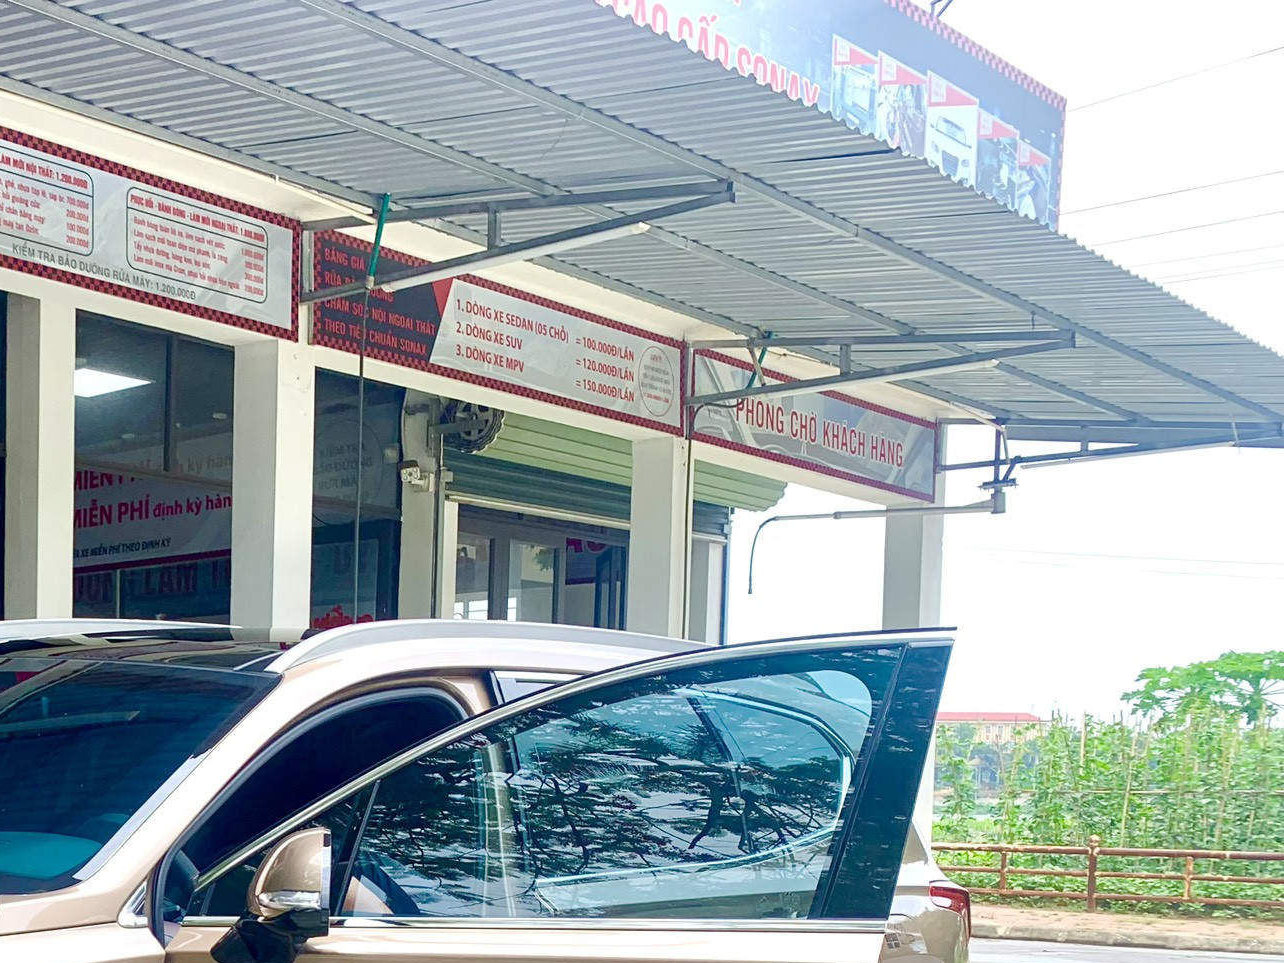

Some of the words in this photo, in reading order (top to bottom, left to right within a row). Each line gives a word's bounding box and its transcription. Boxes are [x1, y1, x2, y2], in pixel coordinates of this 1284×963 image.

[13, 240, 35, 259] KIỂM
[38, 251, 55, 264] TRA
[58, 252, 76, 270] BẢO
[113, 267, 130, 284] RỬA
[456, 298, 465, 313] 1.
[465, 300, 492, 320] DÒNG
[493, 308, 504, 323] XE
[506, 311, 534, 332] SEDAN
[535, 320, 547, 336] (05
[548, 322, 569, 345] CHỖ)
[456, 322, 465, 336] 2.
[465, 322, 492, 343] DÒNG
[493, 332, 504, 346] XE
[506, 335, 523, 350] SUV
[456, 344, 465, 358] 3.
[465, 346, 492, 365] DÒNG
[493, 354, 504, 368] XE
[506, 357, 525, 373] MPV
[790, 409, 819, 443] CHỜ
[822, 417, 867, 458] KHÁCH
[870, 429, 904, 469] HÀNG
[118, 494, 151, 524] PHÍ
[153, 502, 183, 521] định
[186, 496, 203, 515] kỳ
[205, 494, 232, 511] hàn
[121, 541, 141, 552] THEO
